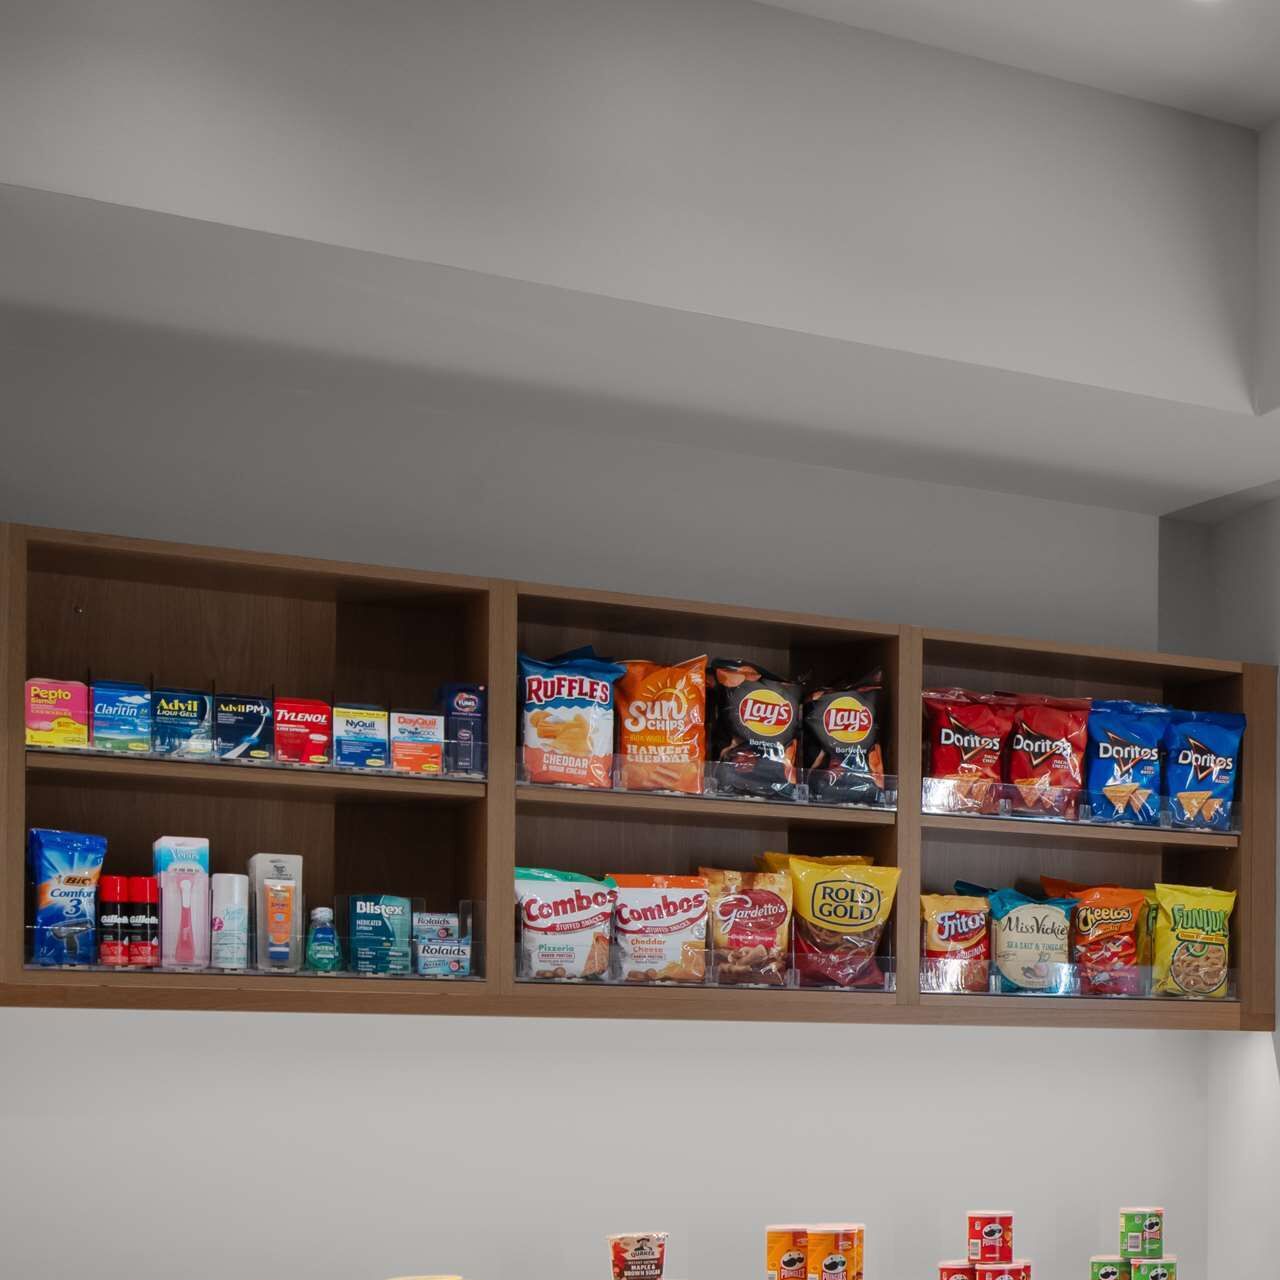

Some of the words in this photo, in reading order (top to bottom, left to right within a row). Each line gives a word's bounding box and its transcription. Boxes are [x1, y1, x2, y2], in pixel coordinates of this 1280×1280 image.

[31, 686, 71, 701] Pepto
[526, 675, 610, 705] RUFFLES
[95, 702, 137, 717] Claritin
[156, 698, 198, 712] Advil
[218, 703, 245, 713] Advil
[245, 704, 265, 714] PM
[744, 700, 790, 726] Lay's
[276, 709, 328, 723] TYLENOL
[345, 719, 376, 729] NyQuil
[397, 715, 437, 727] DayQuil
[828, 707, 869, 732] Lay's
[941, 728, 1000, 751] Doritos
[1013, 734, 1072, 755] Doritos
[1099, 742, 1159, 761] Doritos
[1178, 750, 1233, 771] Doritos
[50, 888, 96, 898] Comfor
[822, 886, 875, 904] ROLD
[356, 901, 403, 917] Blistex
[524, 889, 618, 922] Combos
[616, 892, 706, 926] Combos
[716, 895, 785, 934] Gardetto's
[819, 902, 873, 920] GOLD
[936, 911, 986, 940] Fritos
[1002, 916, 1034, 934] Miss
[1077, 906, 1131, 934] Cheetos
[421, 945, 467, 957] Rolaids
